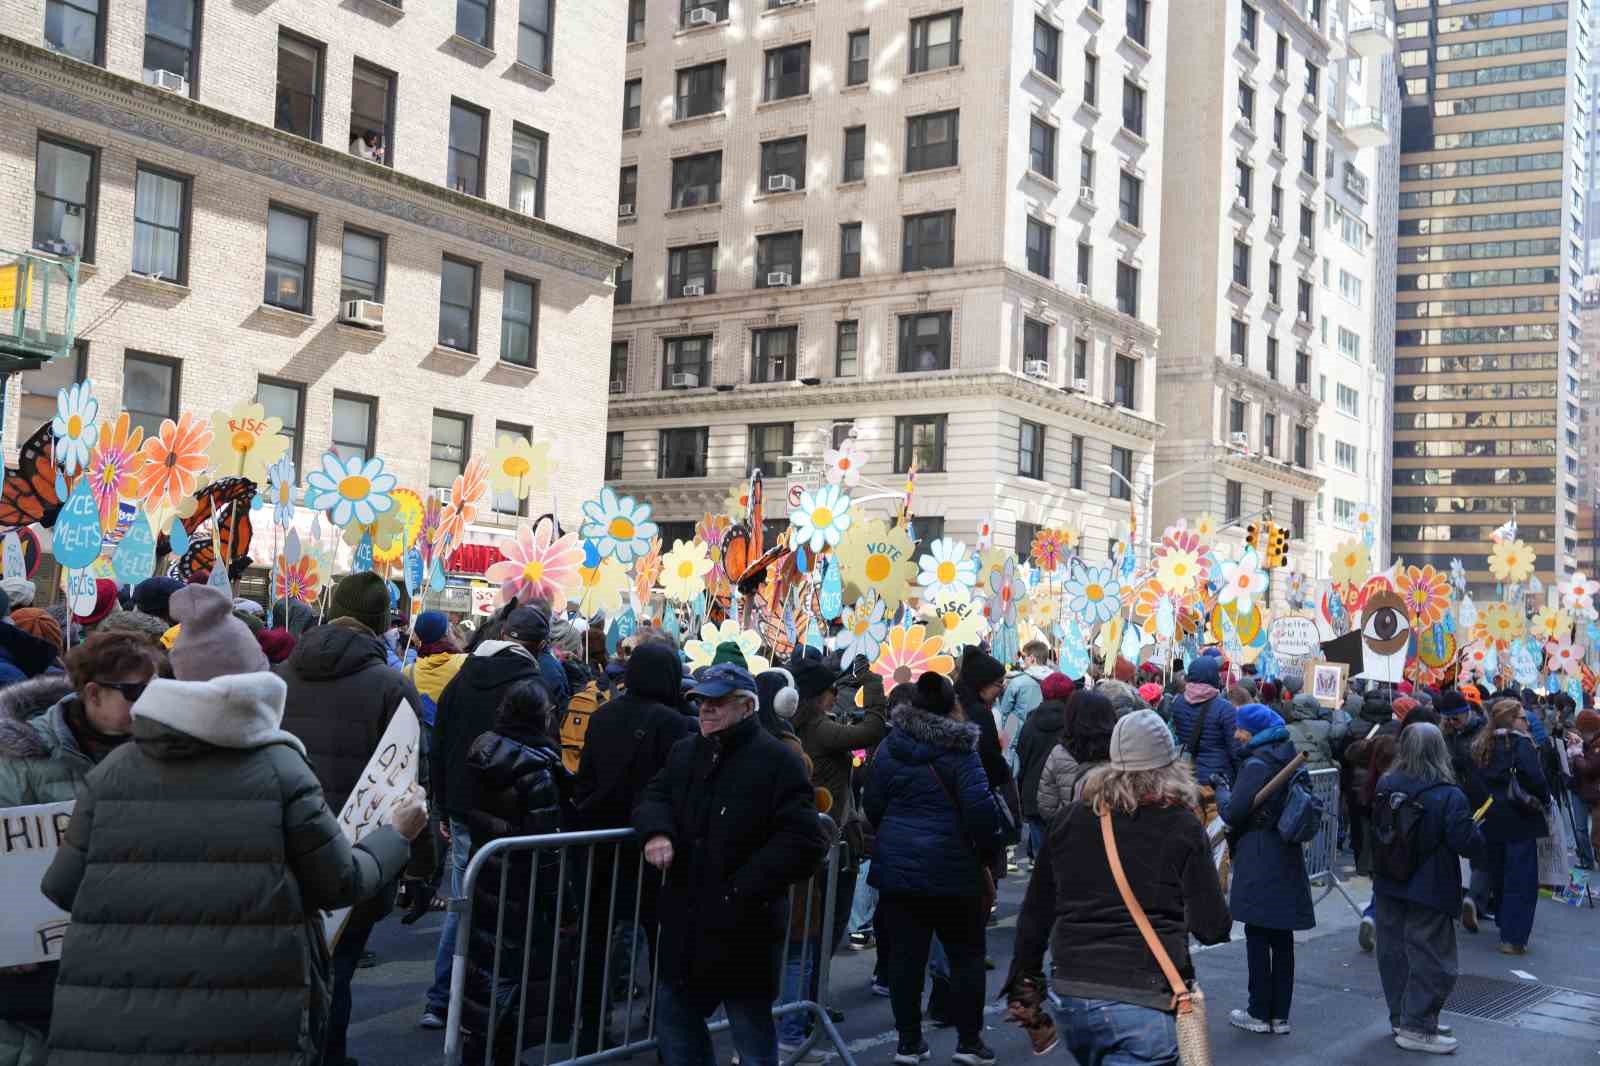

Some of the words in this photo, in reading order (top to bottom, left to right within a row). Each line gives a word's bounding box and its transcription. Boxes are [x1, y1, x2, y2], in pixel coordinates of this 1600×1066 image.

[227, 418, 268, 437] RISE
[65, 494, 94, 516] ICE
[53, 520, 101, 552] MELTS
[357, 543, 372, 561] ICE
[867, 543, 902, 561] VOTE
[936, 601, 973, 621] RISE!
[343, 743, 397, 825] PAID
